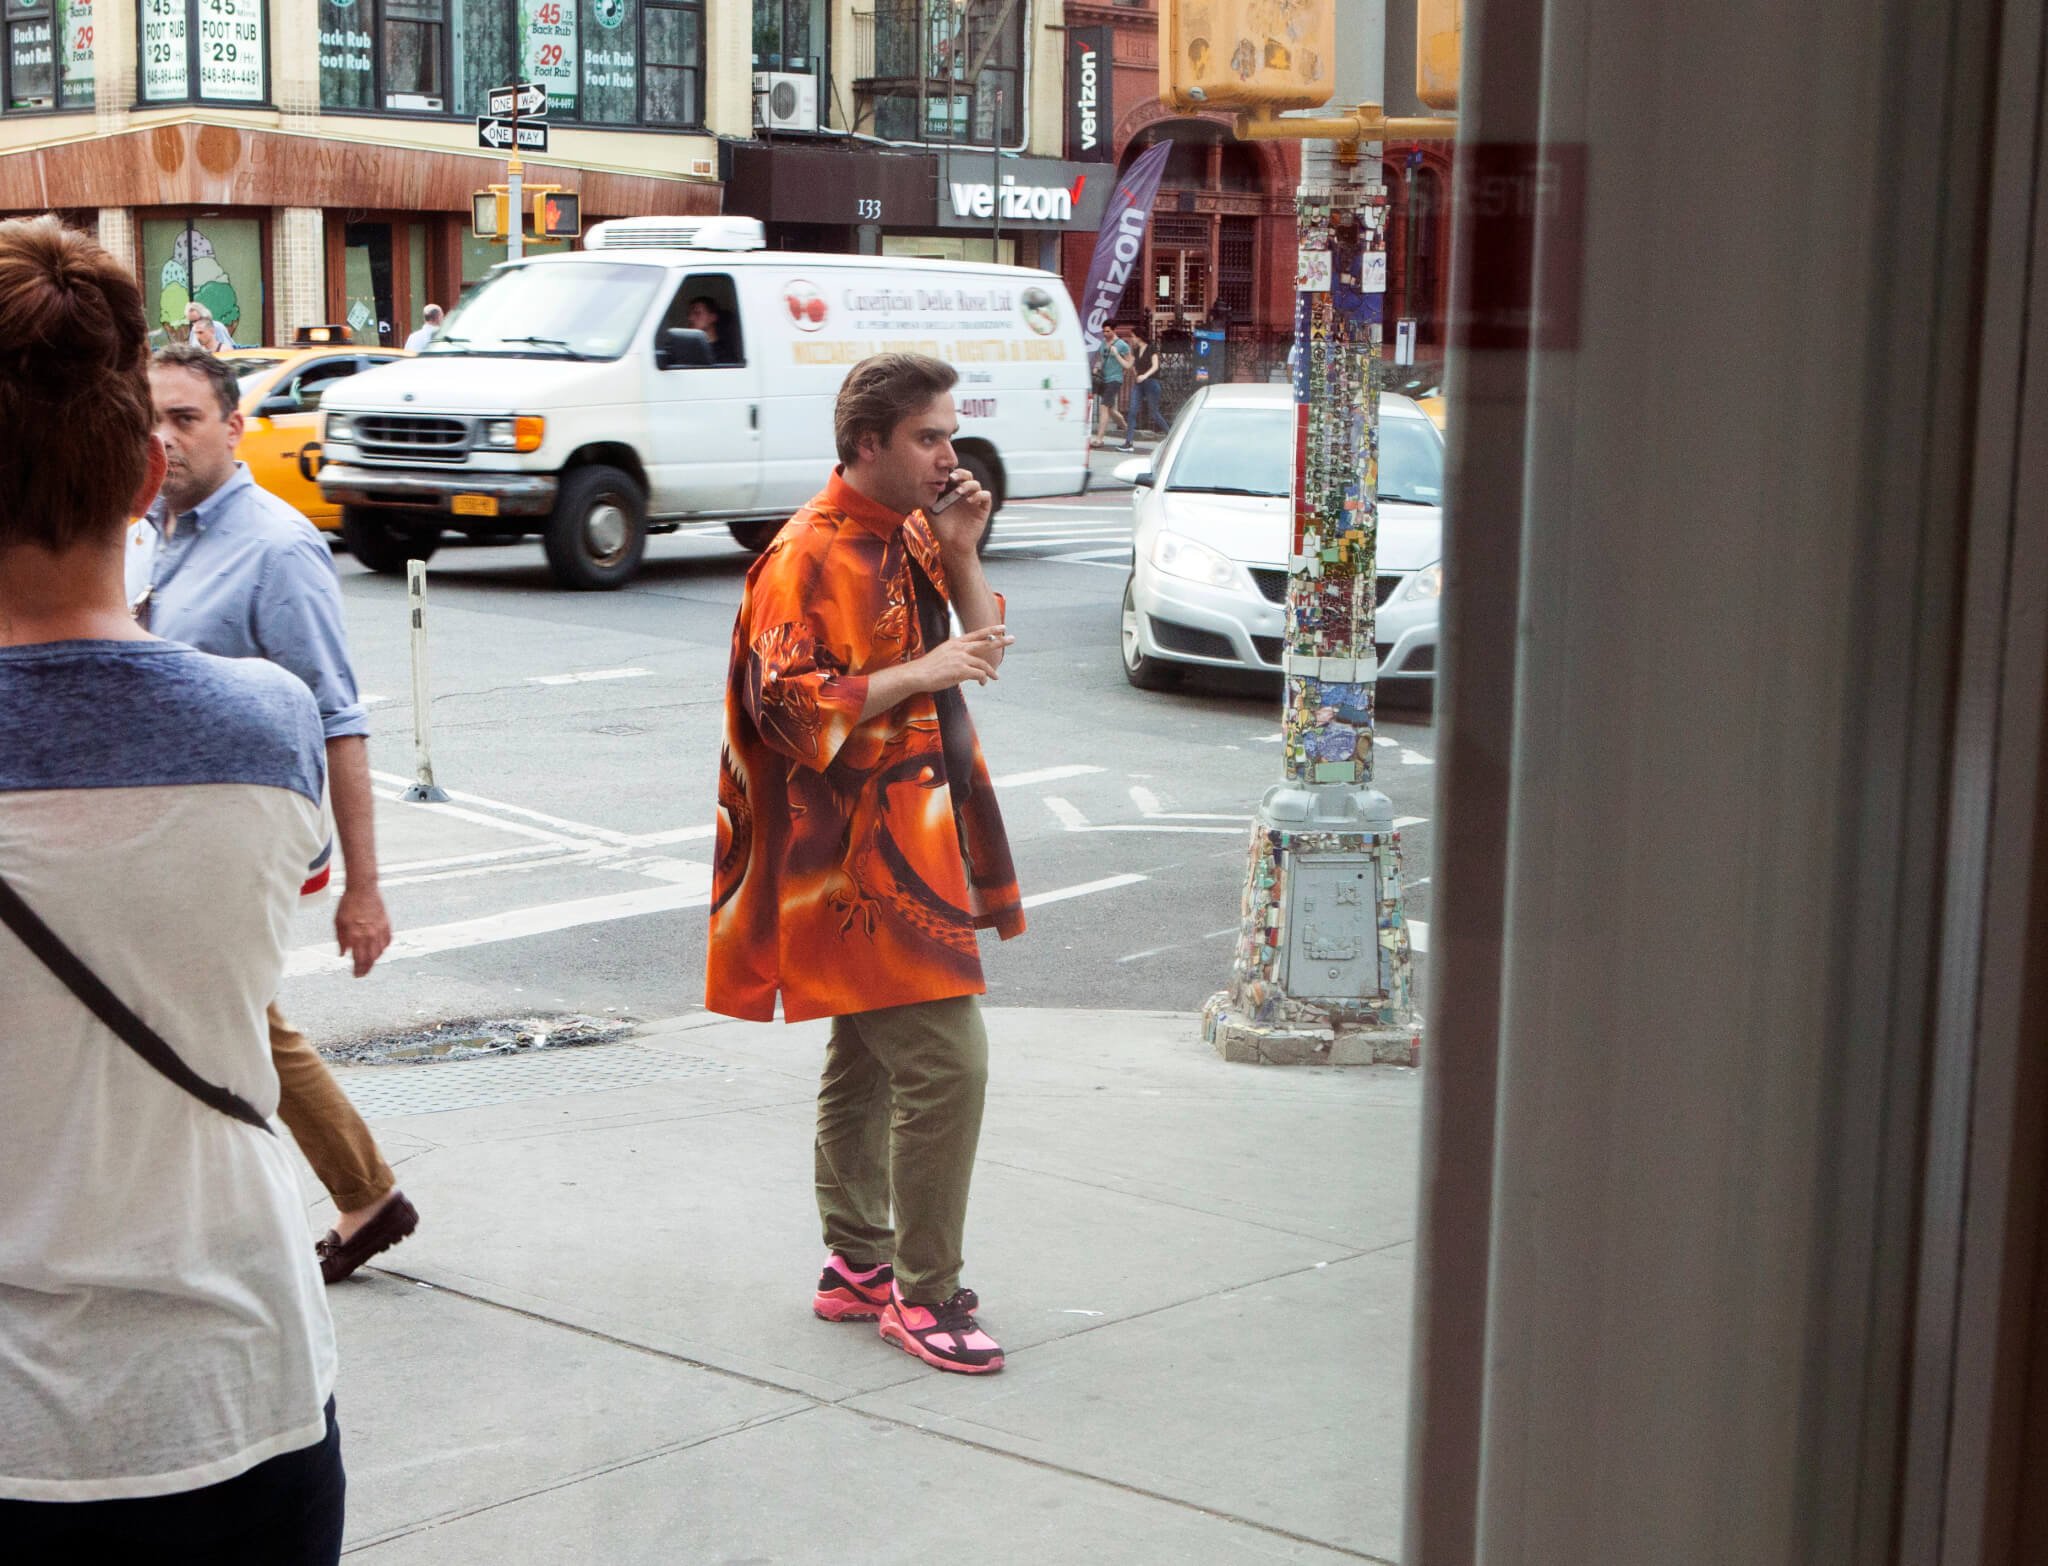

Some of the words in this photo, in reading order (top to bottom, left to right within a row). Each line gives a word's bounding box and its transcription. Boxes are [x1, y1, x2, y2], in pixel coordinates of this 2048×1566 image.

[13, 27, 34, 44] Back
[146, 21, 166, 40] FOOT
[169, 20, 185, 39] RUB
[202, 20, 232, 39] FOOT
[235, 22, 257, 40] RUB
[346, 30, 371, 48] Rub
[532, 24, 553, 34] Back
[554, 26, 571, 36] Rub
[14, 49, 35, 66] Foot
[346, 53, 370, 71] Rub
[584, 49, 611, 64] Back
[613, 52, 635, 67] Rub
[534, 66, 553, 77] Foot
[554, 67, 571, 78] Rub
[584, 71, 611, 86] Foot
[612, 73, 635, 88] Rub
[493, 97, 512, 111] ONE
[521, 95, 540, 106] WAY
[1078, 51, 1097, 150] verizon
[489, 127, 509, 141] ONE
[518, 130, 539, 142] WAY
[950, 174, 1072, 221] verizon
[857, 199, 881, 220] 133
[1083, 207, 1145, 353] verizon
[1200, 340, 1209, 355] P
